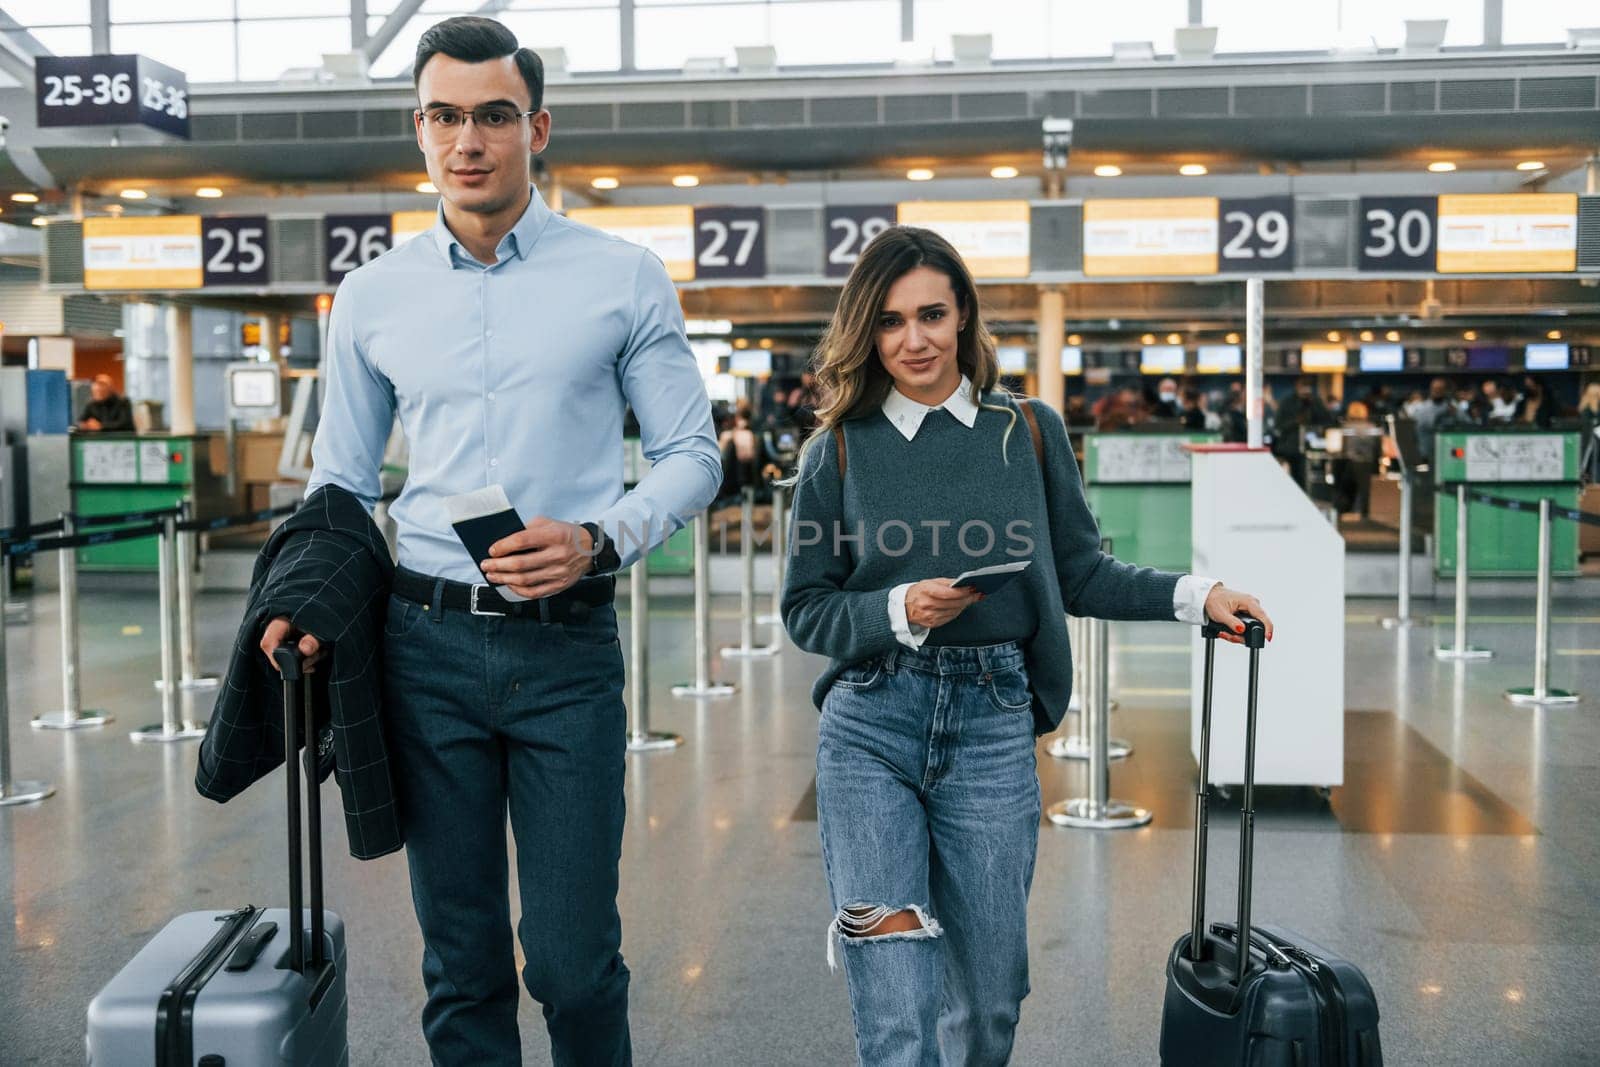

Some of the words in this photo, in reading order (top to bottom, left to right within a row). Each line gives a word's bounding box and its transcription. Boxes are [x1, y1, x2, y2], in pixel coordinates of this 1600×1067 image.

[44, 73, 132, 106] 25-36
[143, 77, 188, 120] 25-36
[207, 228, 265, 273] 25
[330, 226, 388, 272] 26
[699, 220, 759, 266] 27
[1223, 211, 1289, 259] 29
[1364, 209, 1431, 257] 30
